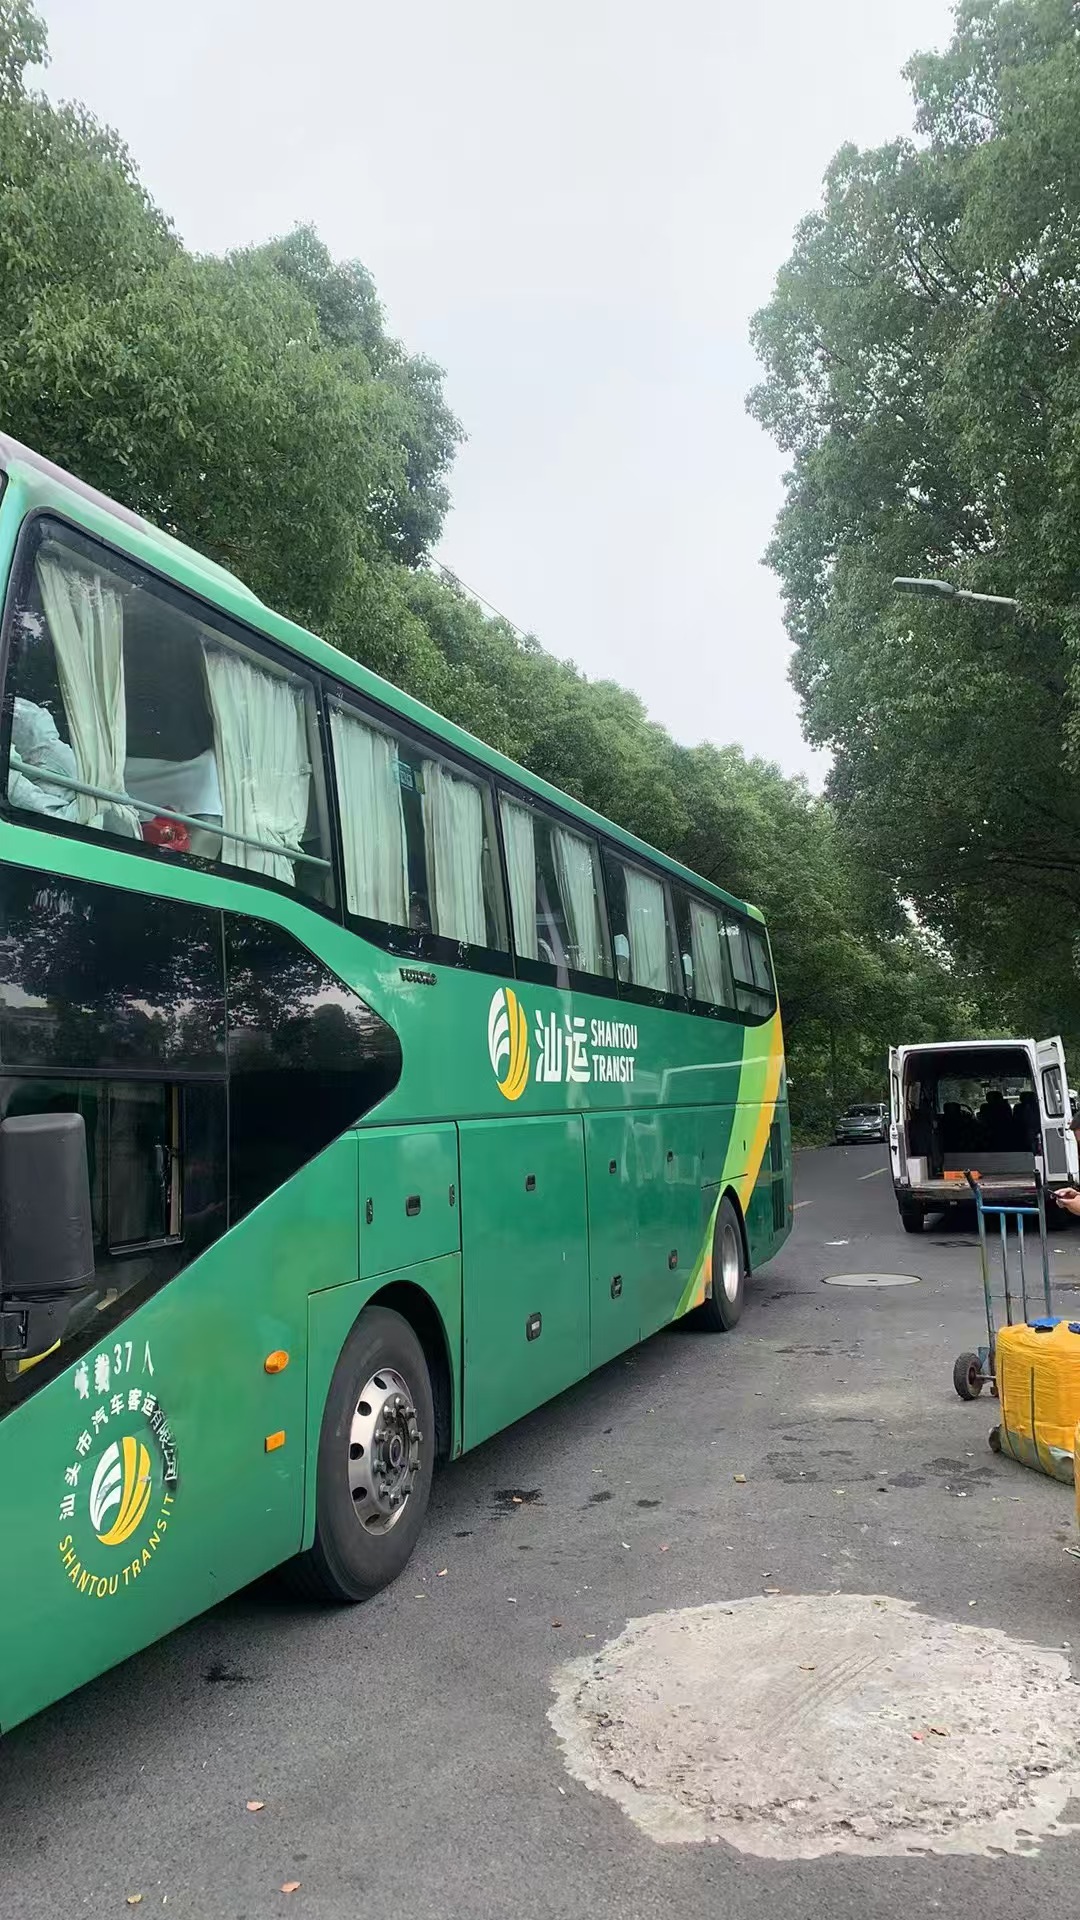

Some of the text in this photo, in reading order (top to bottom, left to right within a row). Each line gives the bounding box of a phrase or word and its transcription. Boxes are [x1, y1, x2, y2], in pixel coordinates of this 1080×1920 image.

[534, 1009, 591, 1083] 汕运
[591, 1018, 638, 1050] SHANTOU
[592, 1054, 636, 1083] TRANSIT
[59, 1492, 176, 1598] SHANTOU TRANSIT
